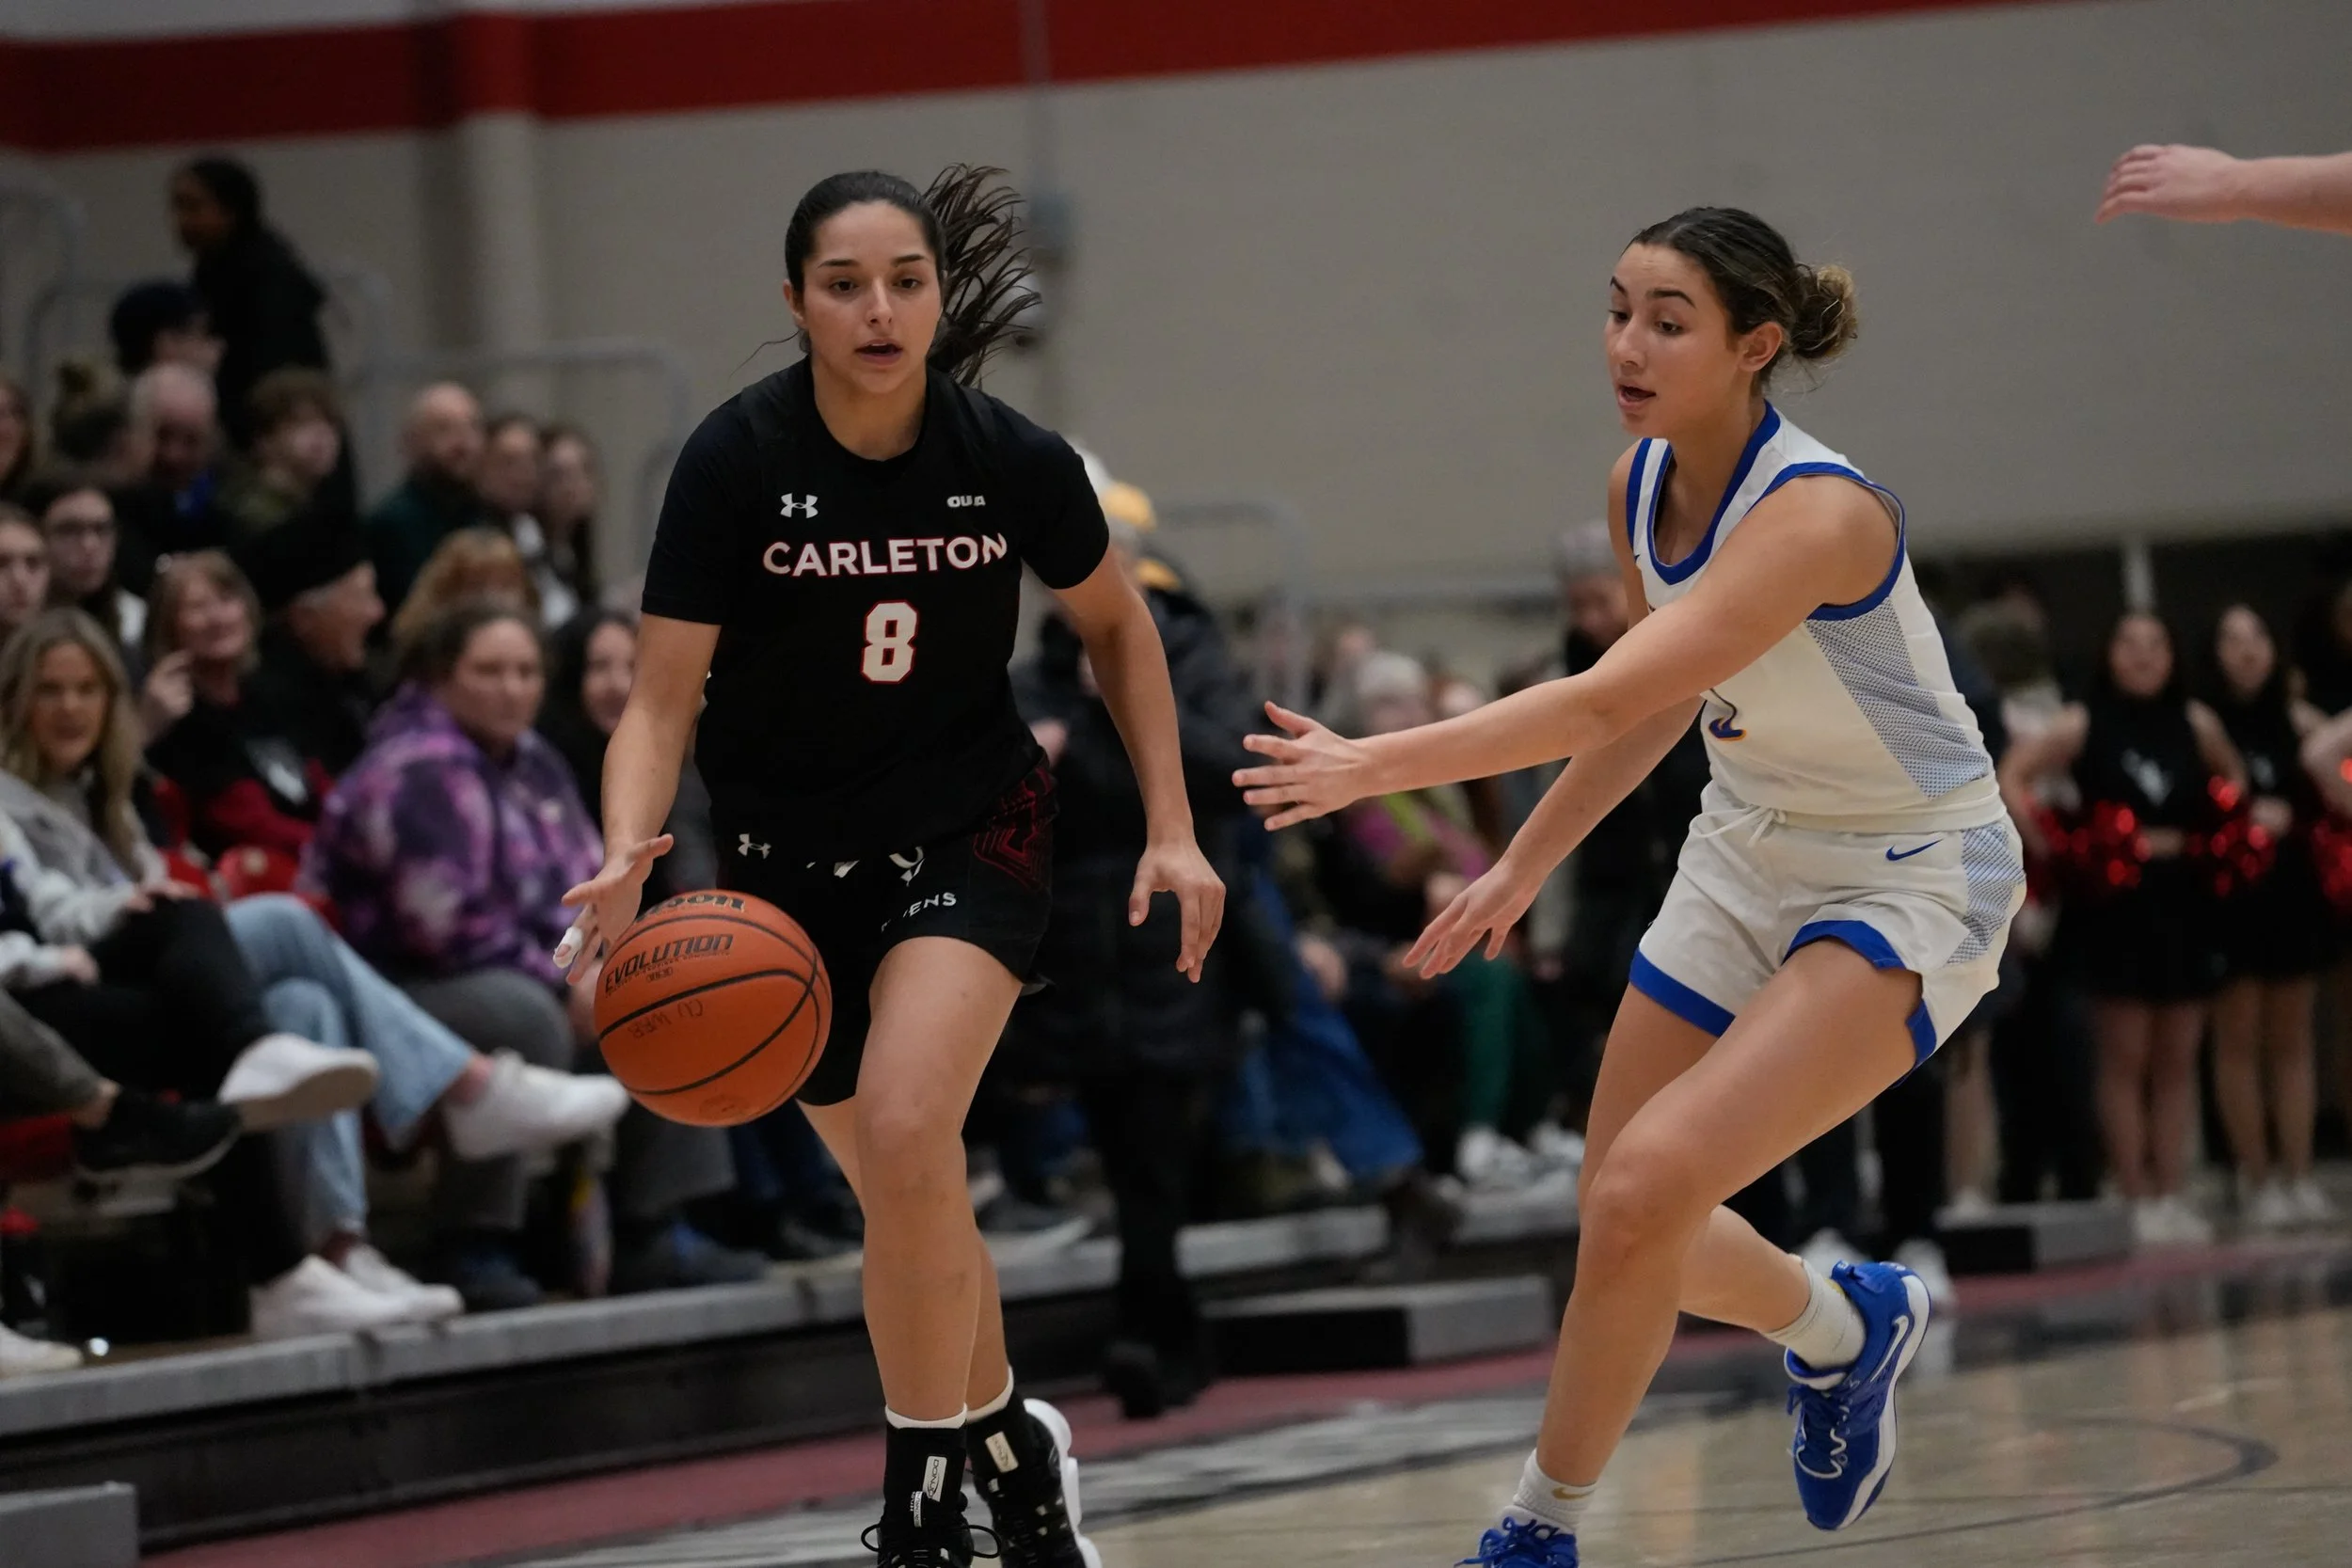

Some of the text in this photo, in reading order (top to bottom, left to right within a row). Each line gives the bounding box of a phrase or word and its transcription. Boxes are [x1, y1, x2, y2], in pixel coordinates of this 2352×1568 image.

[946, 495, 986, 508] OUA
[761, 532, 1009, 577] CARLETON
[861, 600, 918, 684] 8
[605, 933, 734, 994] EVOLUTION
